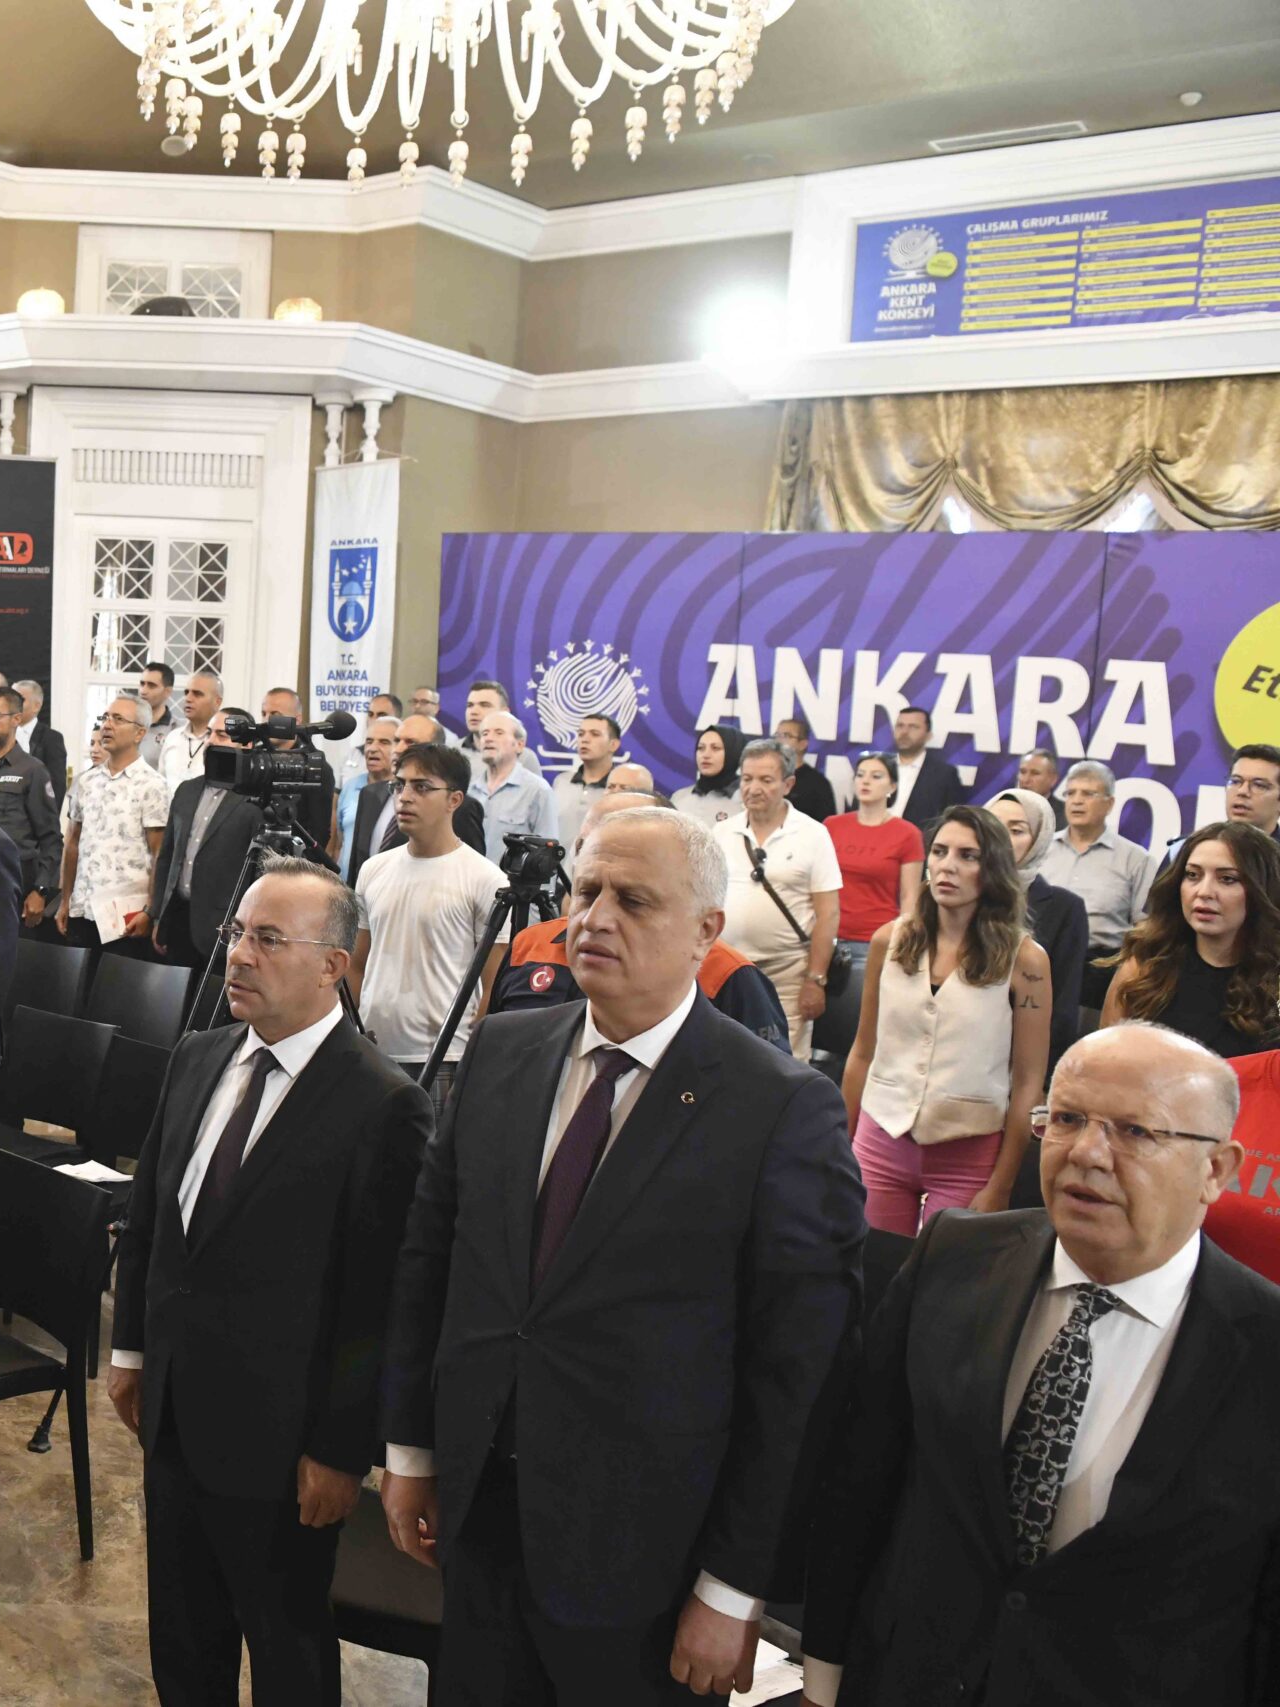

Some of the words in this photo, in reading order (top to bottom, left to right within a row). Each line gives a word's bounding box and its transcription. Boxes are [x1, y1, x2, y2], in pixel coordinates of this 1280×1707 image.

[1021, 210, 1109, 229] GRUPLARIMIZ
[880, 282, 937, 298] ANKARA
[889, 295, 926, 309] KENT
[330, 537, 379, 547] ANKARA
[327, 669, 369, 681] ANKARA
[694, 643, 1176, 767] ANKARA
